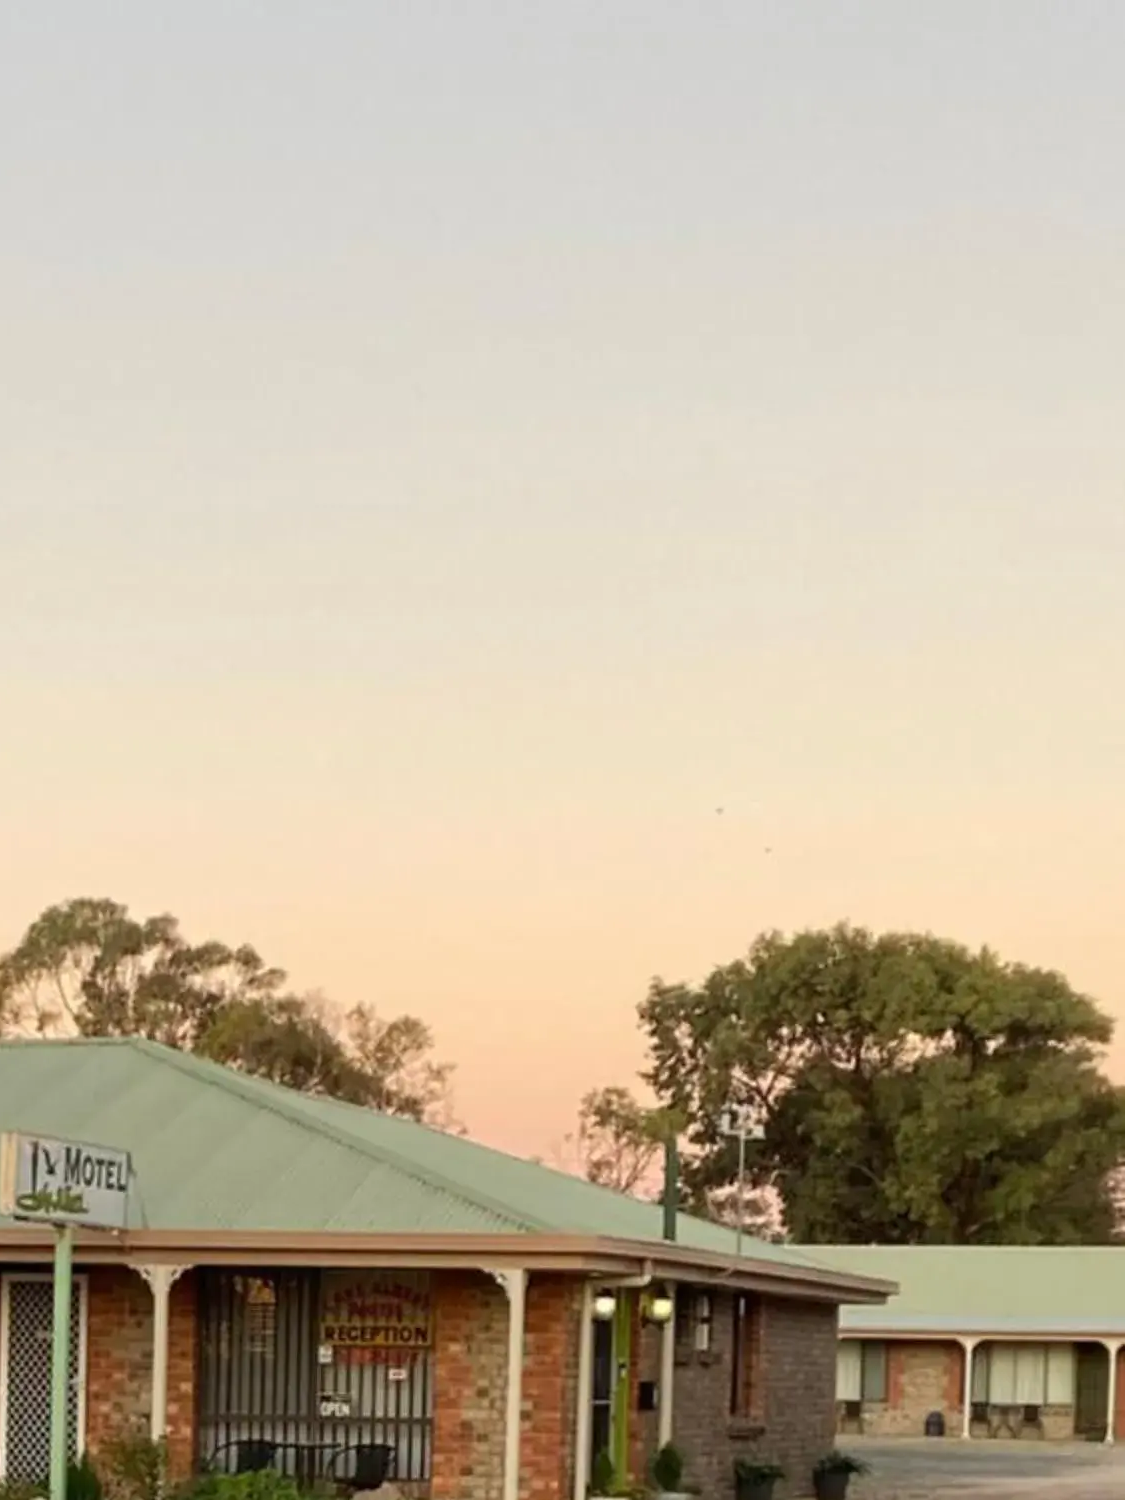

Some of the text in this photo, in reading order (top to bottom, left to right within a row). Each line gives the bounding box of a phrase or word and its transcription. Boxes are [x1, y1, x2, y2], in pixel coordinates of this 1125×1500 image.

[64, 1146, 127, 1191] MOTEL
[325, 1325, 428, 1342] RECEPTION
[320, 1402, 350, 1416] OPEN
